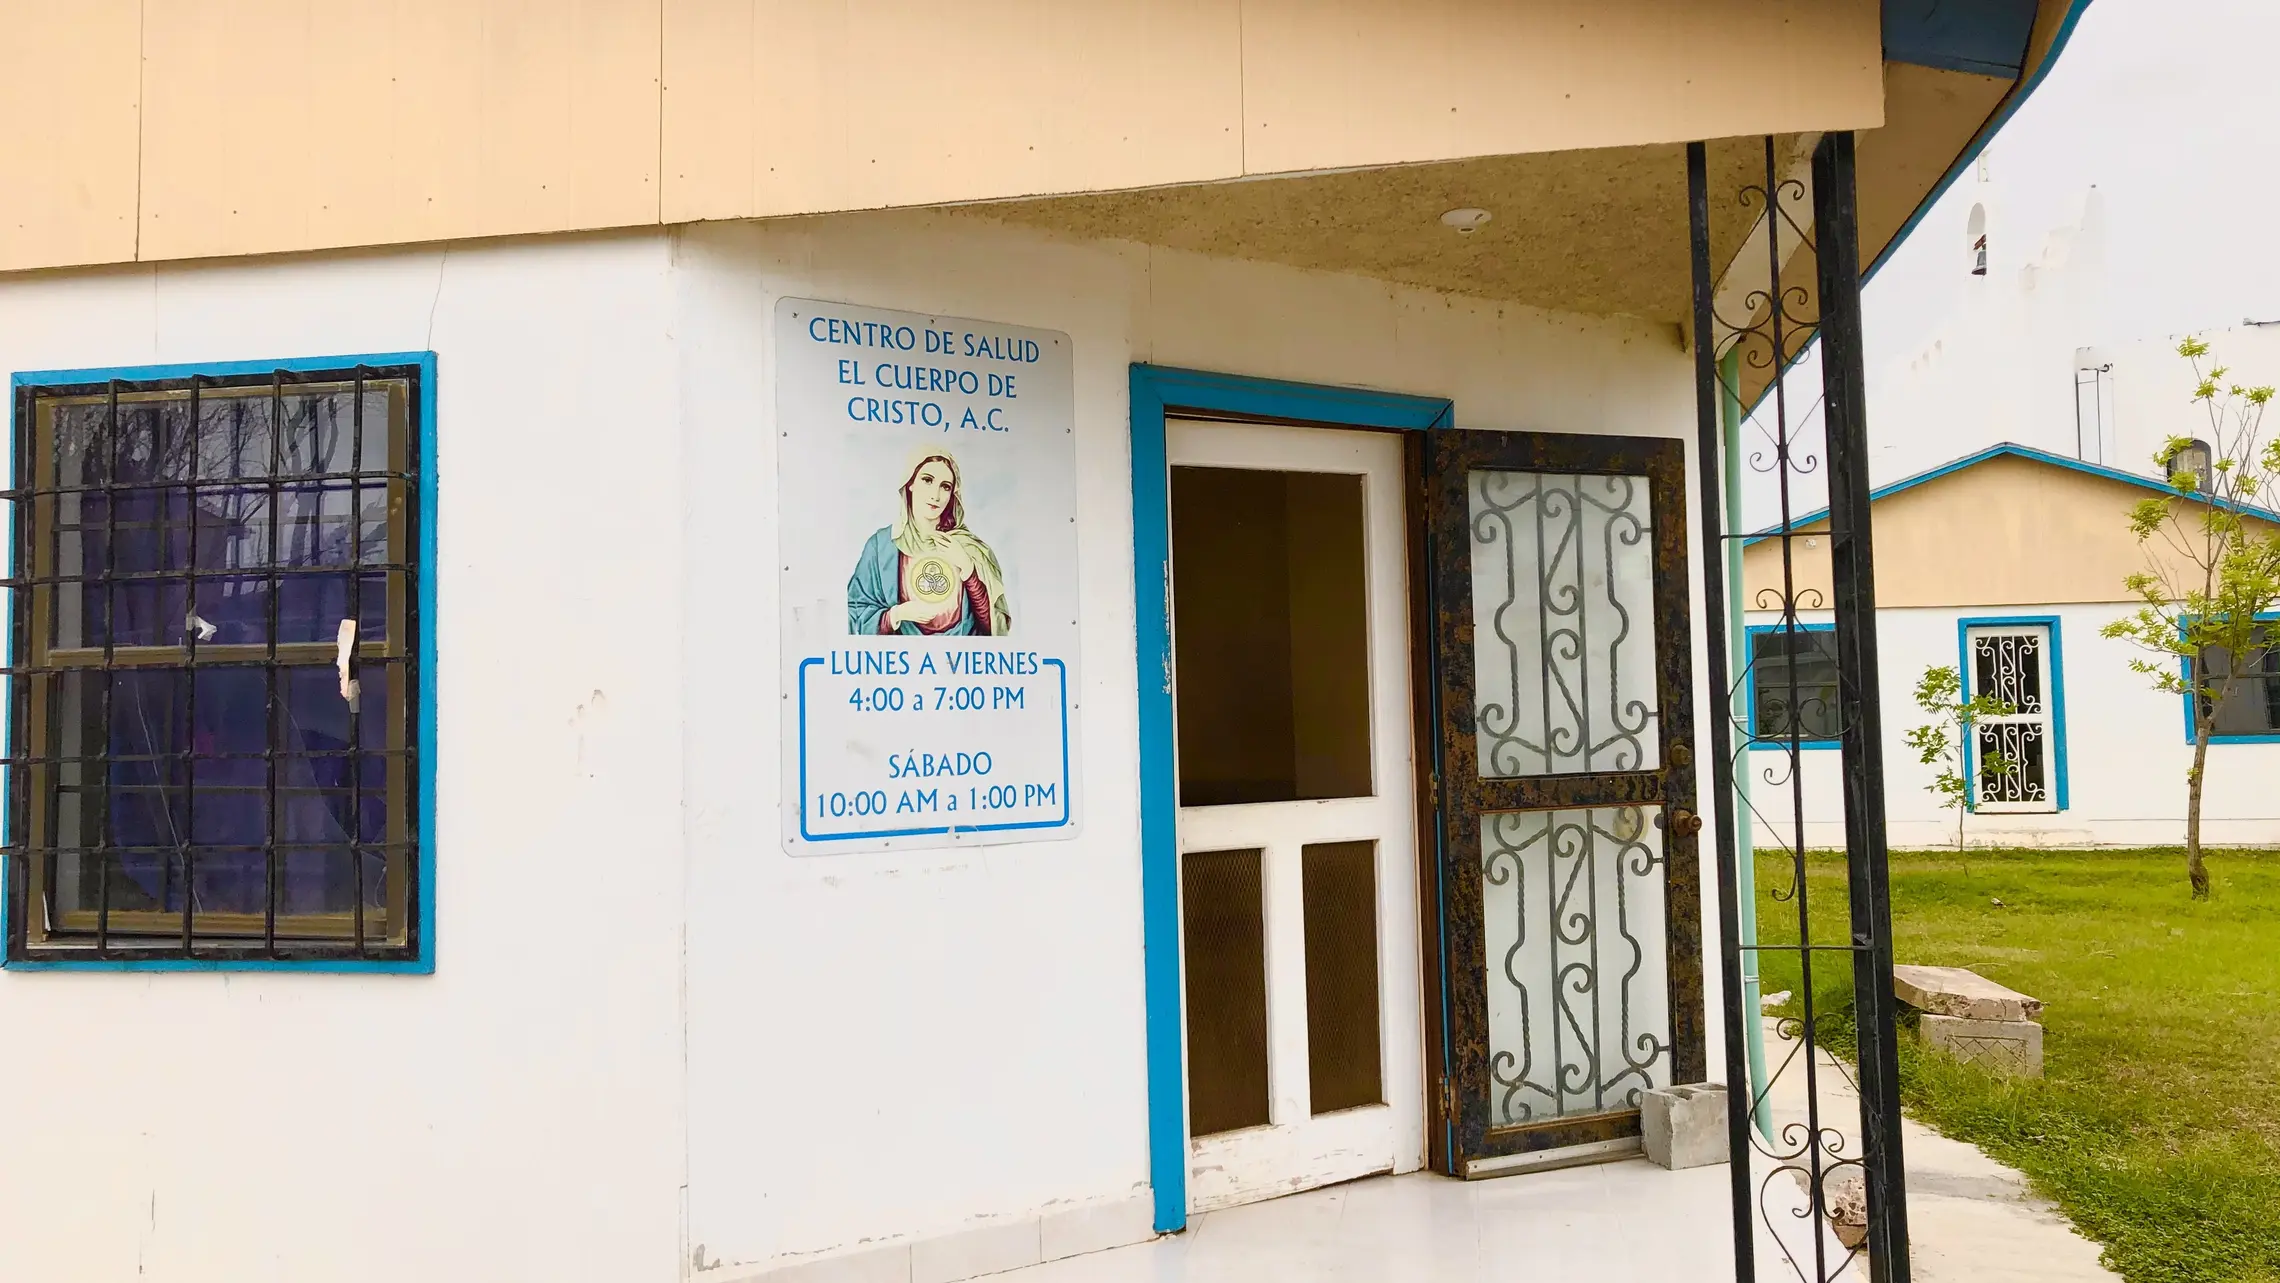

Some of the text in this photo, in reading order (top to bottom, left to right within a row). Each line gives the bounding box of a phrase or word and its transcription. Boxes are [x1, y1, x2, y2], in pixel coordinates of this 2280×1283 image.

[809, 317, 1040, 363] CENTRO DE SALUD
[838, 359, 1018, 399] EL CUERPO DE
[847, 397, 1010, 433] CRISTO, A.C.
[831, 650, 1039, 676] LUNES A VIERNES
[849, 686, 1025, 712] 4:00 a 7:00 PM
[888, 748, 993, 779] SÁBADO
[818, 783, 1056, 819] 10:00 AM a 1:00 PM
